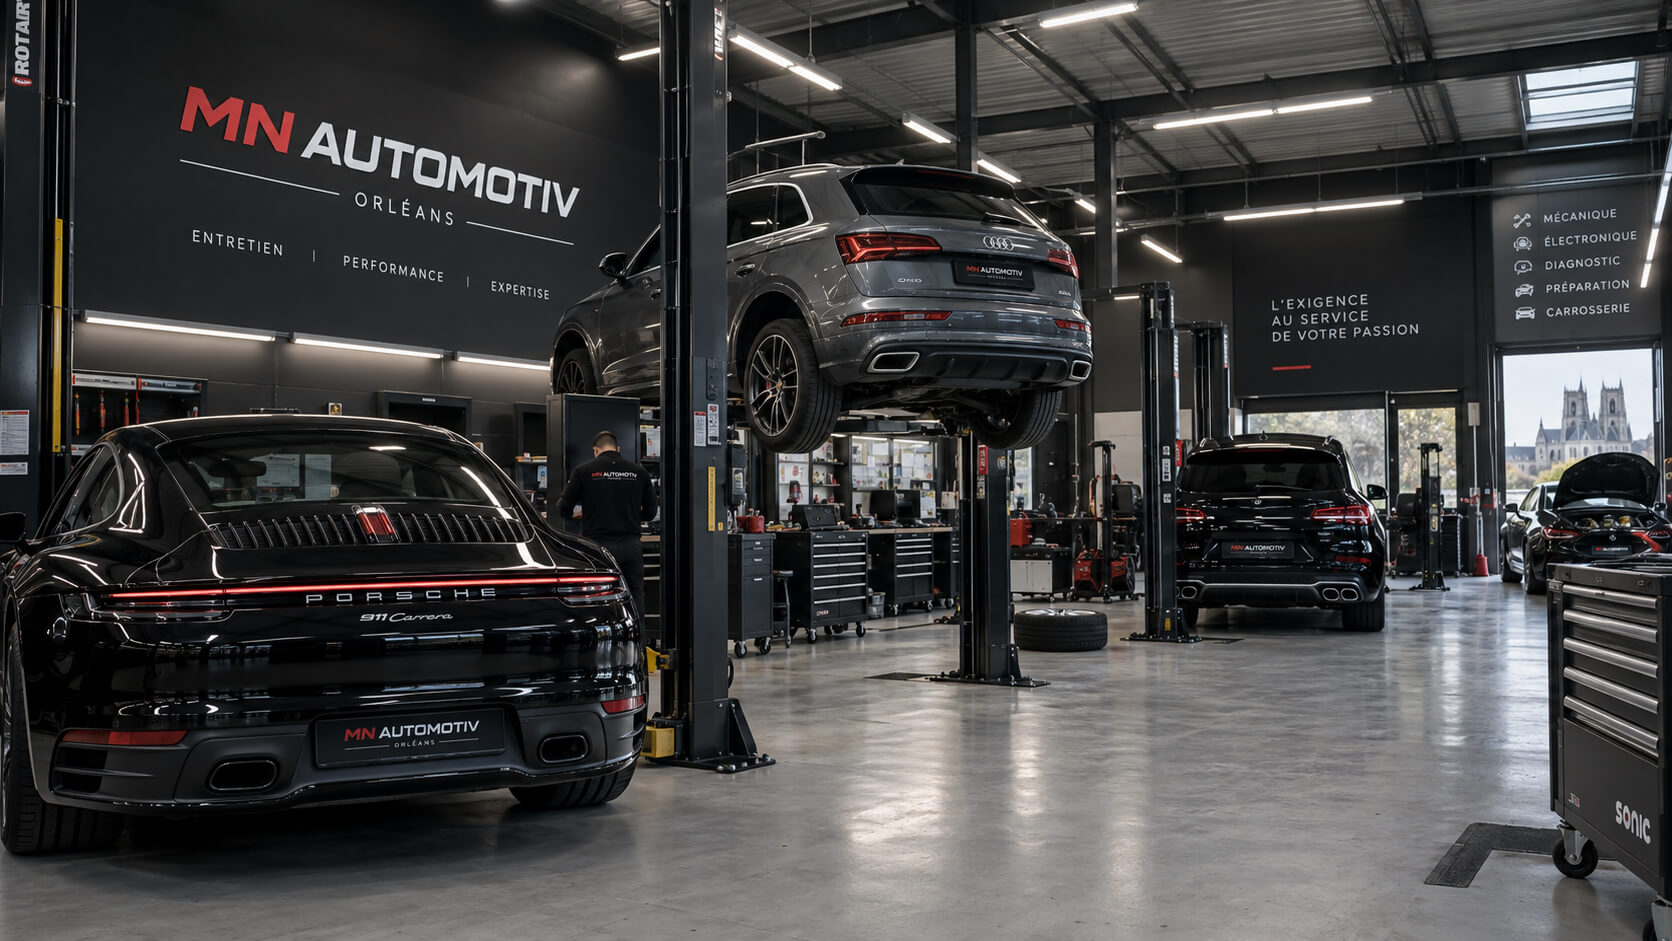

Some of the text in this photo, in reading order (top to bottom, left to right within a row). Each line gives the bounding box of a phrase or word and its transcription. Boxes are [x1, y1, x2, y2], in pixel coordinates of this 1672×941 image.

[15, 0, 31, 76] ROTAR
[180, 86, 581, 218] MN AUTOMOTIV
[354, 192, 456, 227] ORLÉANS
[1543, 208, 1617, 224] MÉCANIQUE
[1544, 230, 1638, 248] ÉLECTRONIQUE
[192, 229, 550, 300] ENTRETIEN PERFORMANCE EXPERTISE
[980, 266, 1024, 277] AUTOMOTIV
[1545, 255, 1621, 271] DIAGNOSTIC
[1545, 279, 1631, 294] PRÉPARATION
[1271, 293, 1369, 312] L'EXIGENCE
[1546, 303, 1631, 318] CARROSSERIE
[1271, 310, 1369, 327] AU SERVICE
[1271, 323, 1420, 343] DE VOTRE PASSION
[305, 588, 497, 604] PORSCHE
[359, 612, 453, 623] 911 Carrera
[344, 720, 480, 742] MN AUTOMOTIV
[394, 739, 436, 749] ORLÉANS
